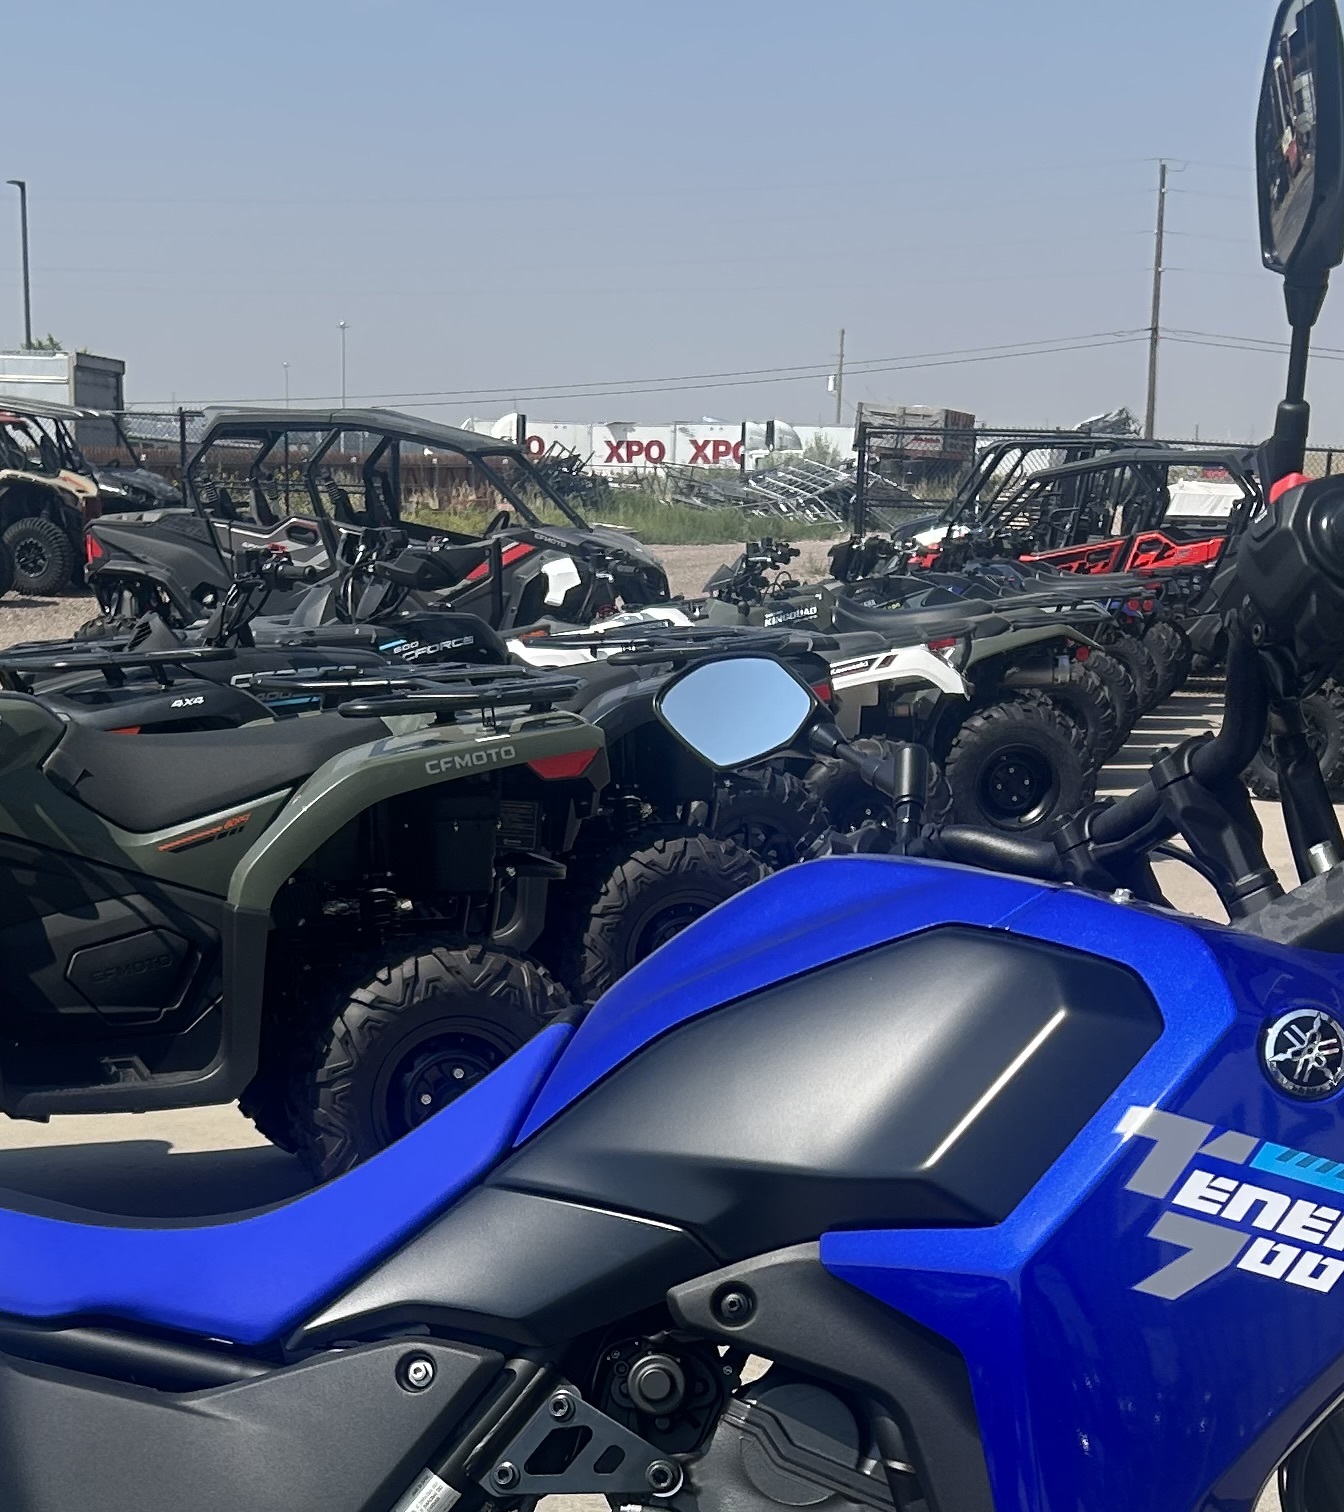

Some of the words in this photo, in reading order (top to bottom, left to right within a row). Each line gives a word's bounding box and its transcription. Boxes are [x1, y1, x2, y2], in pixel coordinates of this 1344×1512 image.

[604, 439, 666, 464] XPO
[401, 634, 475, 662] CFORCE
[424, 745, 517, 776] CFMOTO
